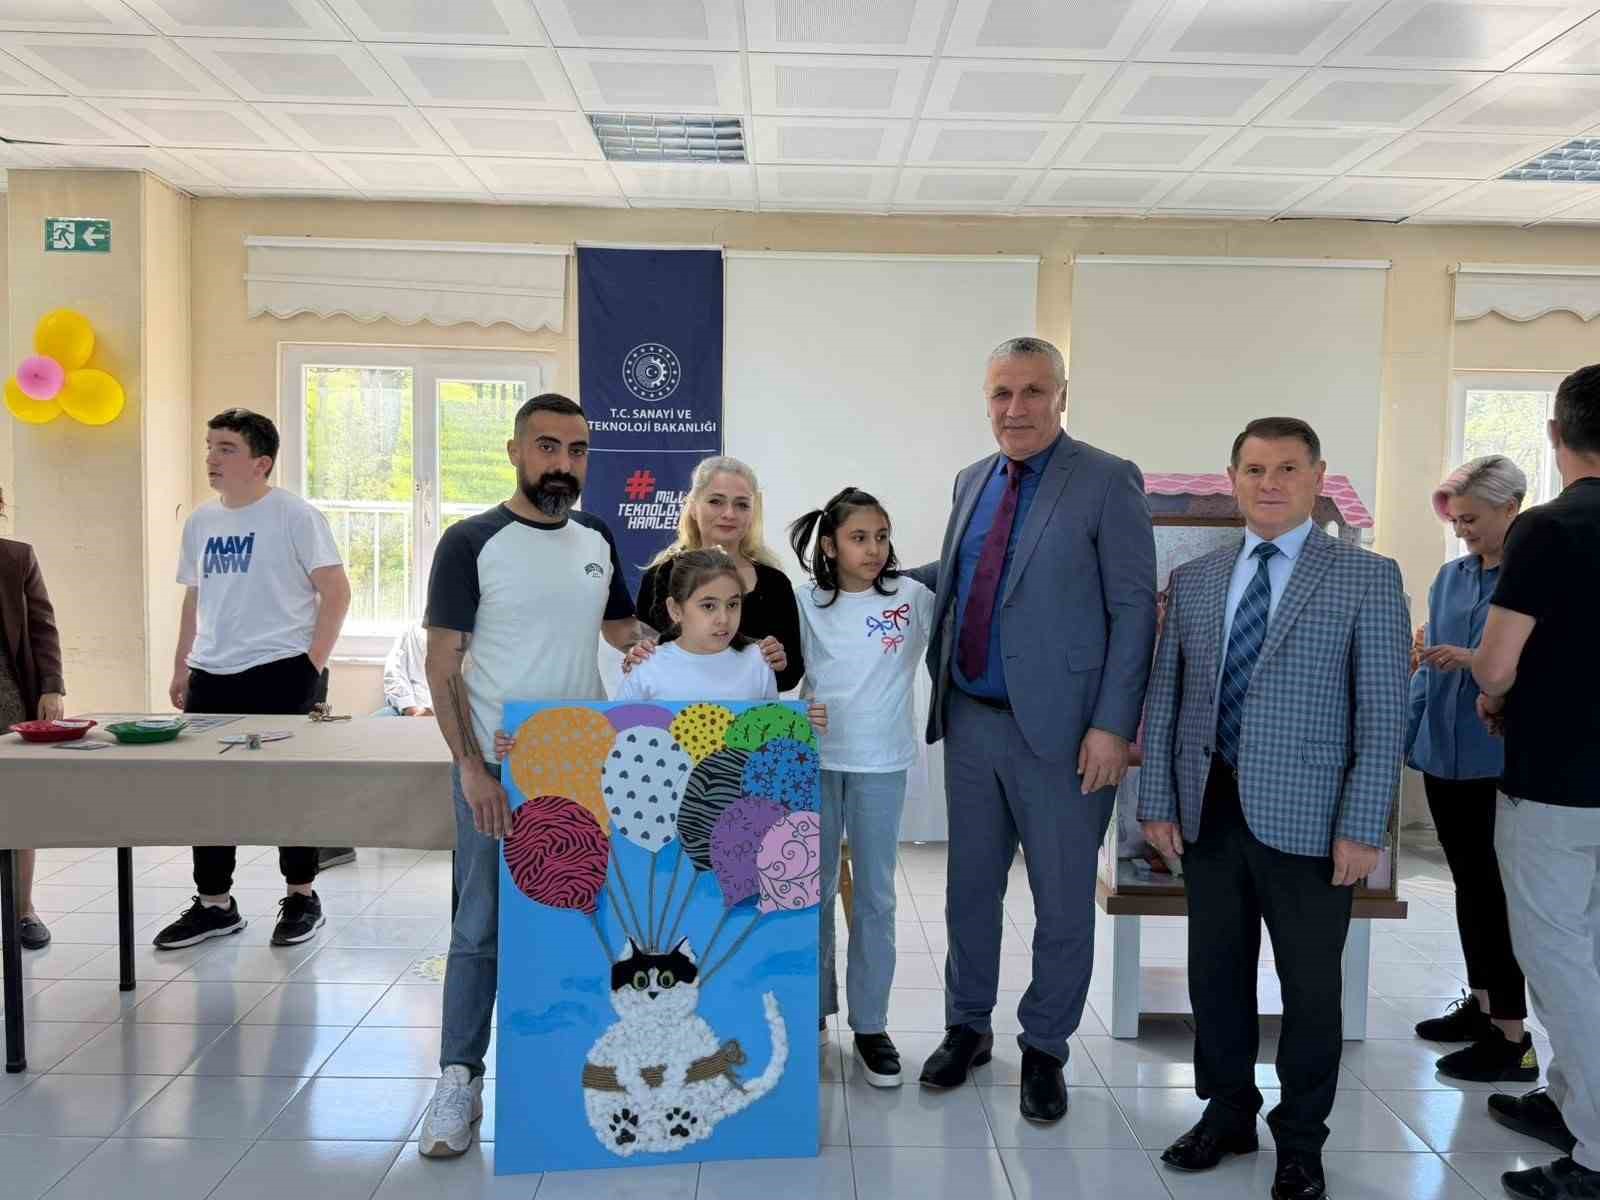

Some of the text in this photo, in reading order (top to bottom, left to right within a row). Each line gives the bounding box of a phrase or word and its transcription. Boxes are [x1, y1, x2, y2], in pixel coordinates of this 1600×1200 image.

[610, 408, 692, 419] T.C. SANAYİ VE
[588, 421, 717, 432] TEKNOLOJİ BAKANLIĞI
[655, 490, 688, 503] MİLL
[618, 503, 686, 517] TEKNOLOJ
[627, 517, 680, 529] HAMLES
[204, 532, 255, 554] MAVİ
